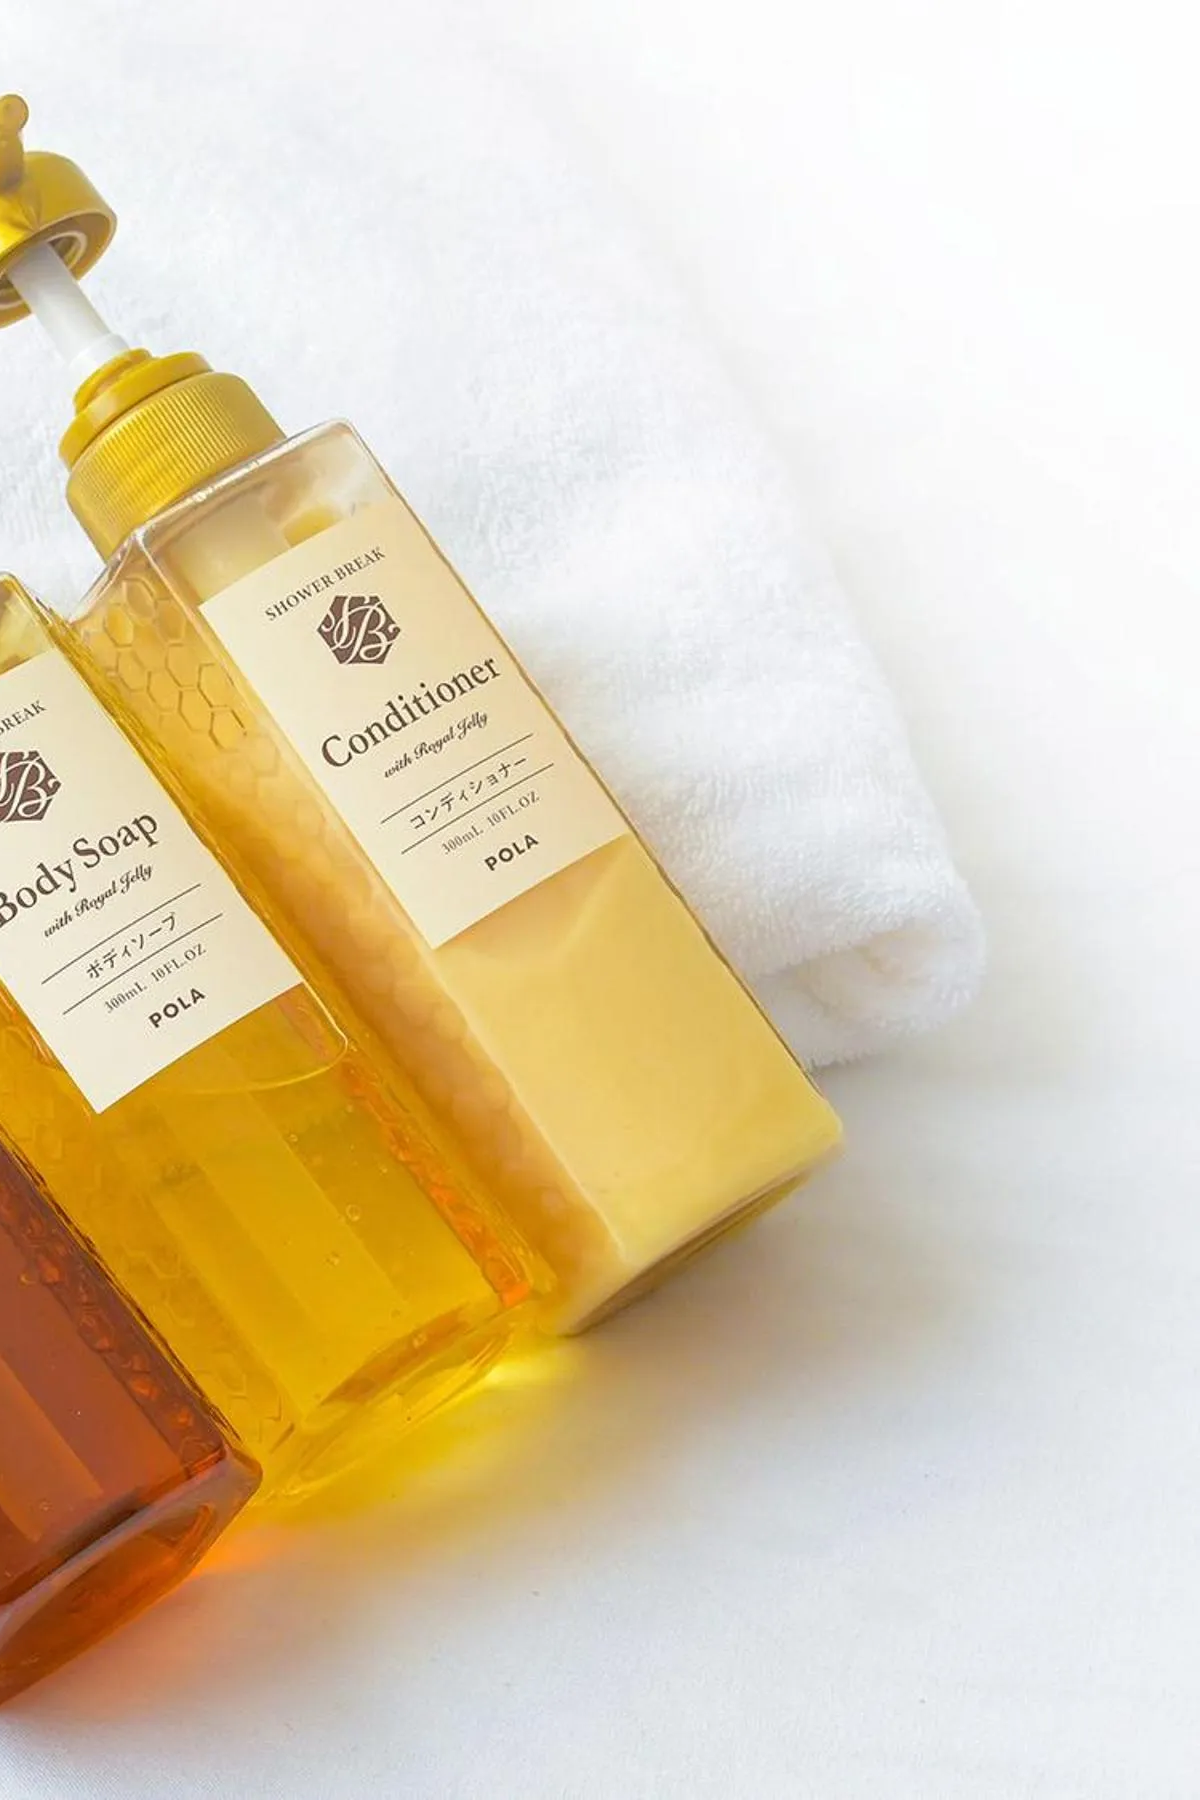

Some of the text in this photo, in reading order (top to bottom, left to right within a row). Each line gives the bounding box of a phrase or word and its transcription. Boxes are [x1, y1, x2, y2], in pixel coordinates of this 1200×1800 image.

[265, 546, 385, 621] SHOWER BREAK
[321, 656, 500, 768] Conditioner
[384, 710, 488, 778] with Royal Jelly
[410, 757, 527, 830] コンディショナー
[72, 814, 158, 870] Soap
[484, 834, 539, 871] POLA
[44, 863, 154, 938] with Royal Jelly
[86, 914, 178, 979] ボディソープ
[149, 988, 206, 1029] POLA
